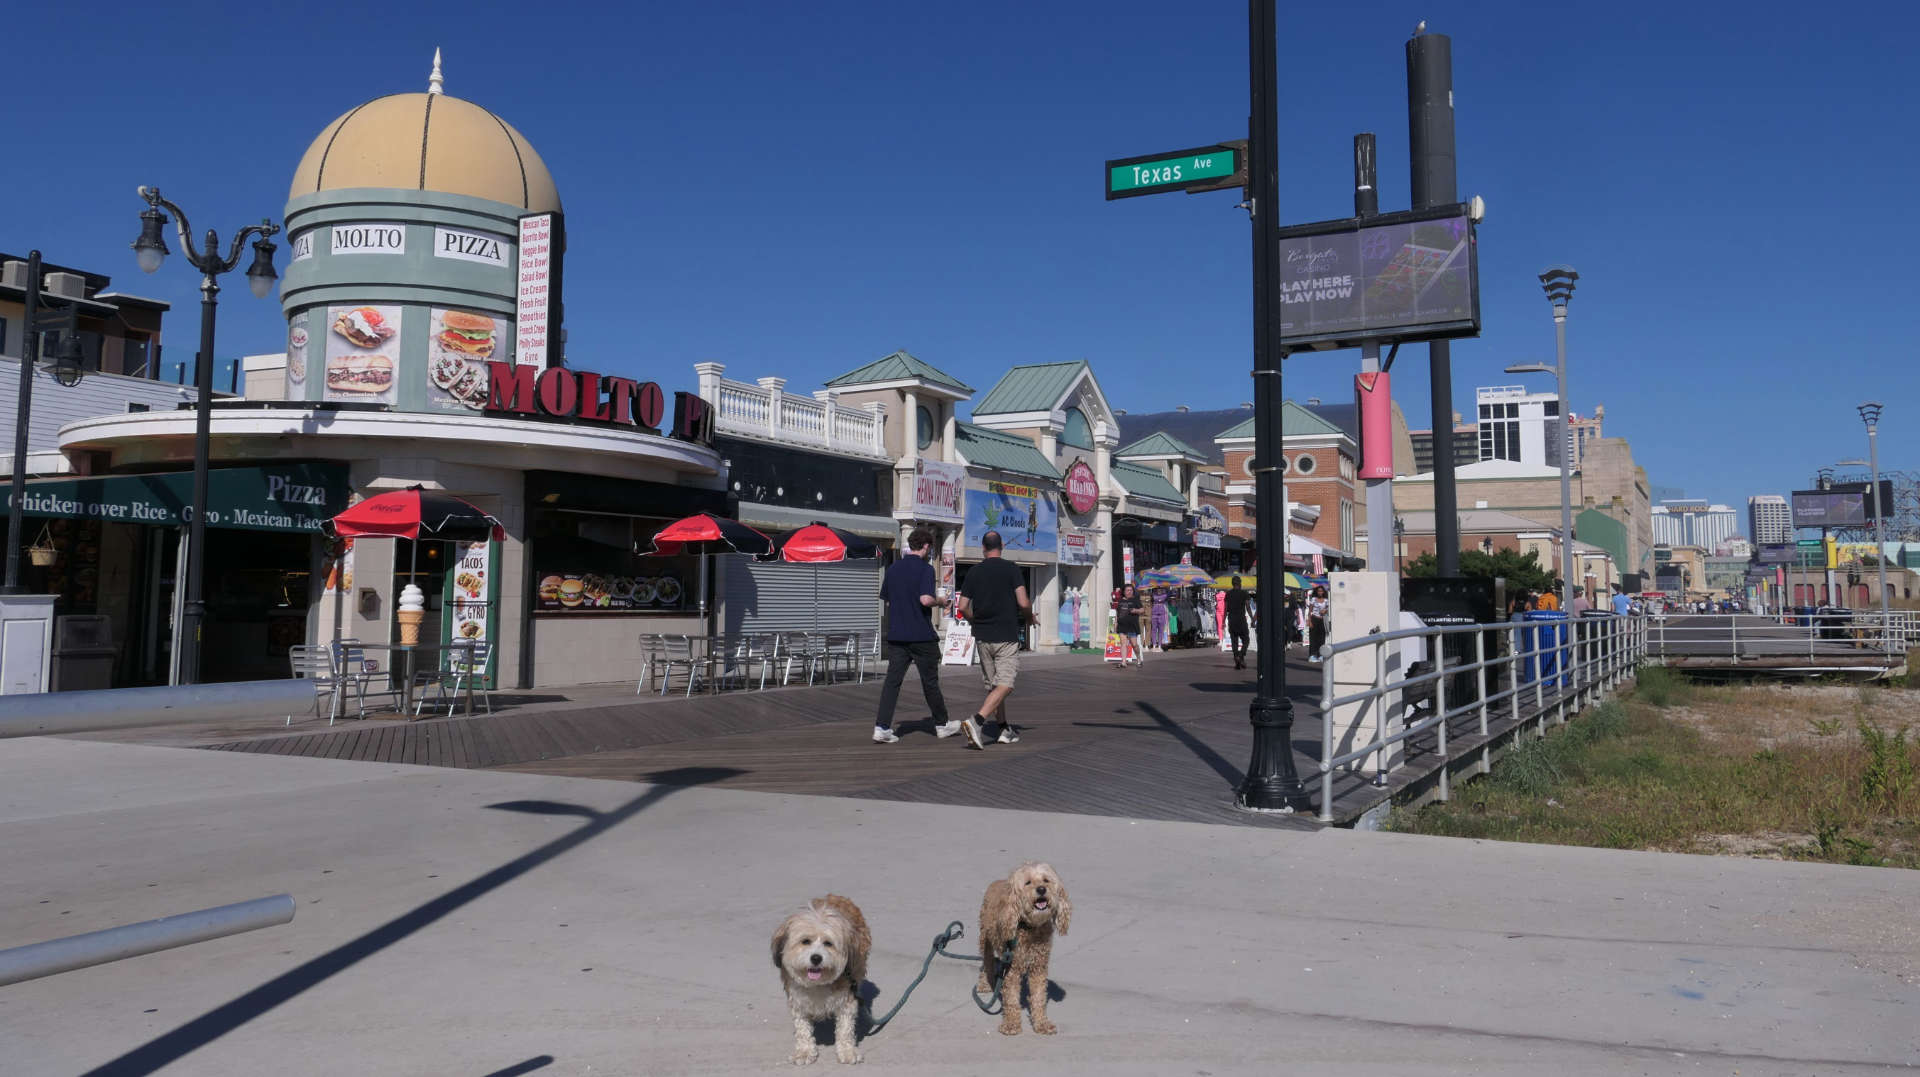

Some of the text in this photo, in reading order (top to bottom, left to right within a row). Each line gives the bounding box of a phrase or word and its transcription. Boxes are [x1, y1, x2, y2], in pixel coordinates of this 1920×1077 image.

[1133, 158, 1212, 185] Texas Ave
[539, 218, 550, 228] Taco
[335, 228, 402, 249] MOLTO
[538, 231, 549, 241] Bowl
[445, 232, 502, 260] PIZZA
[522, 245, 549, 258] Veggie Bowl
[521, 257, 548, 269] Rice Bowl
[521, 270, 548, 282] Salad Bowl
[520, 284, 547, 296] Ice Cream
[1280, 275, 1355, 293] LAY HERE,
[1315, 287, 1353, 301] NOW
[520, 297, 547, 309] Fresh Fruit
[520, 311, 546, 322] Smoothies
[524, 352, 538, 363] Gyro
[486, 361, 665, 428] MOLTO
[266, 475, 327, 505] Pizza
[917, 477, 934, 505] HENNA
[88, 502, 127, 518] over
[131, 501, 167, 520] Rice
[182, 506, 219, 524] Gro
[233, 509, 292, 528] Mexican
[460, 557, 483, 569] TACOS
[467, 605, 485, 619] GYRO
